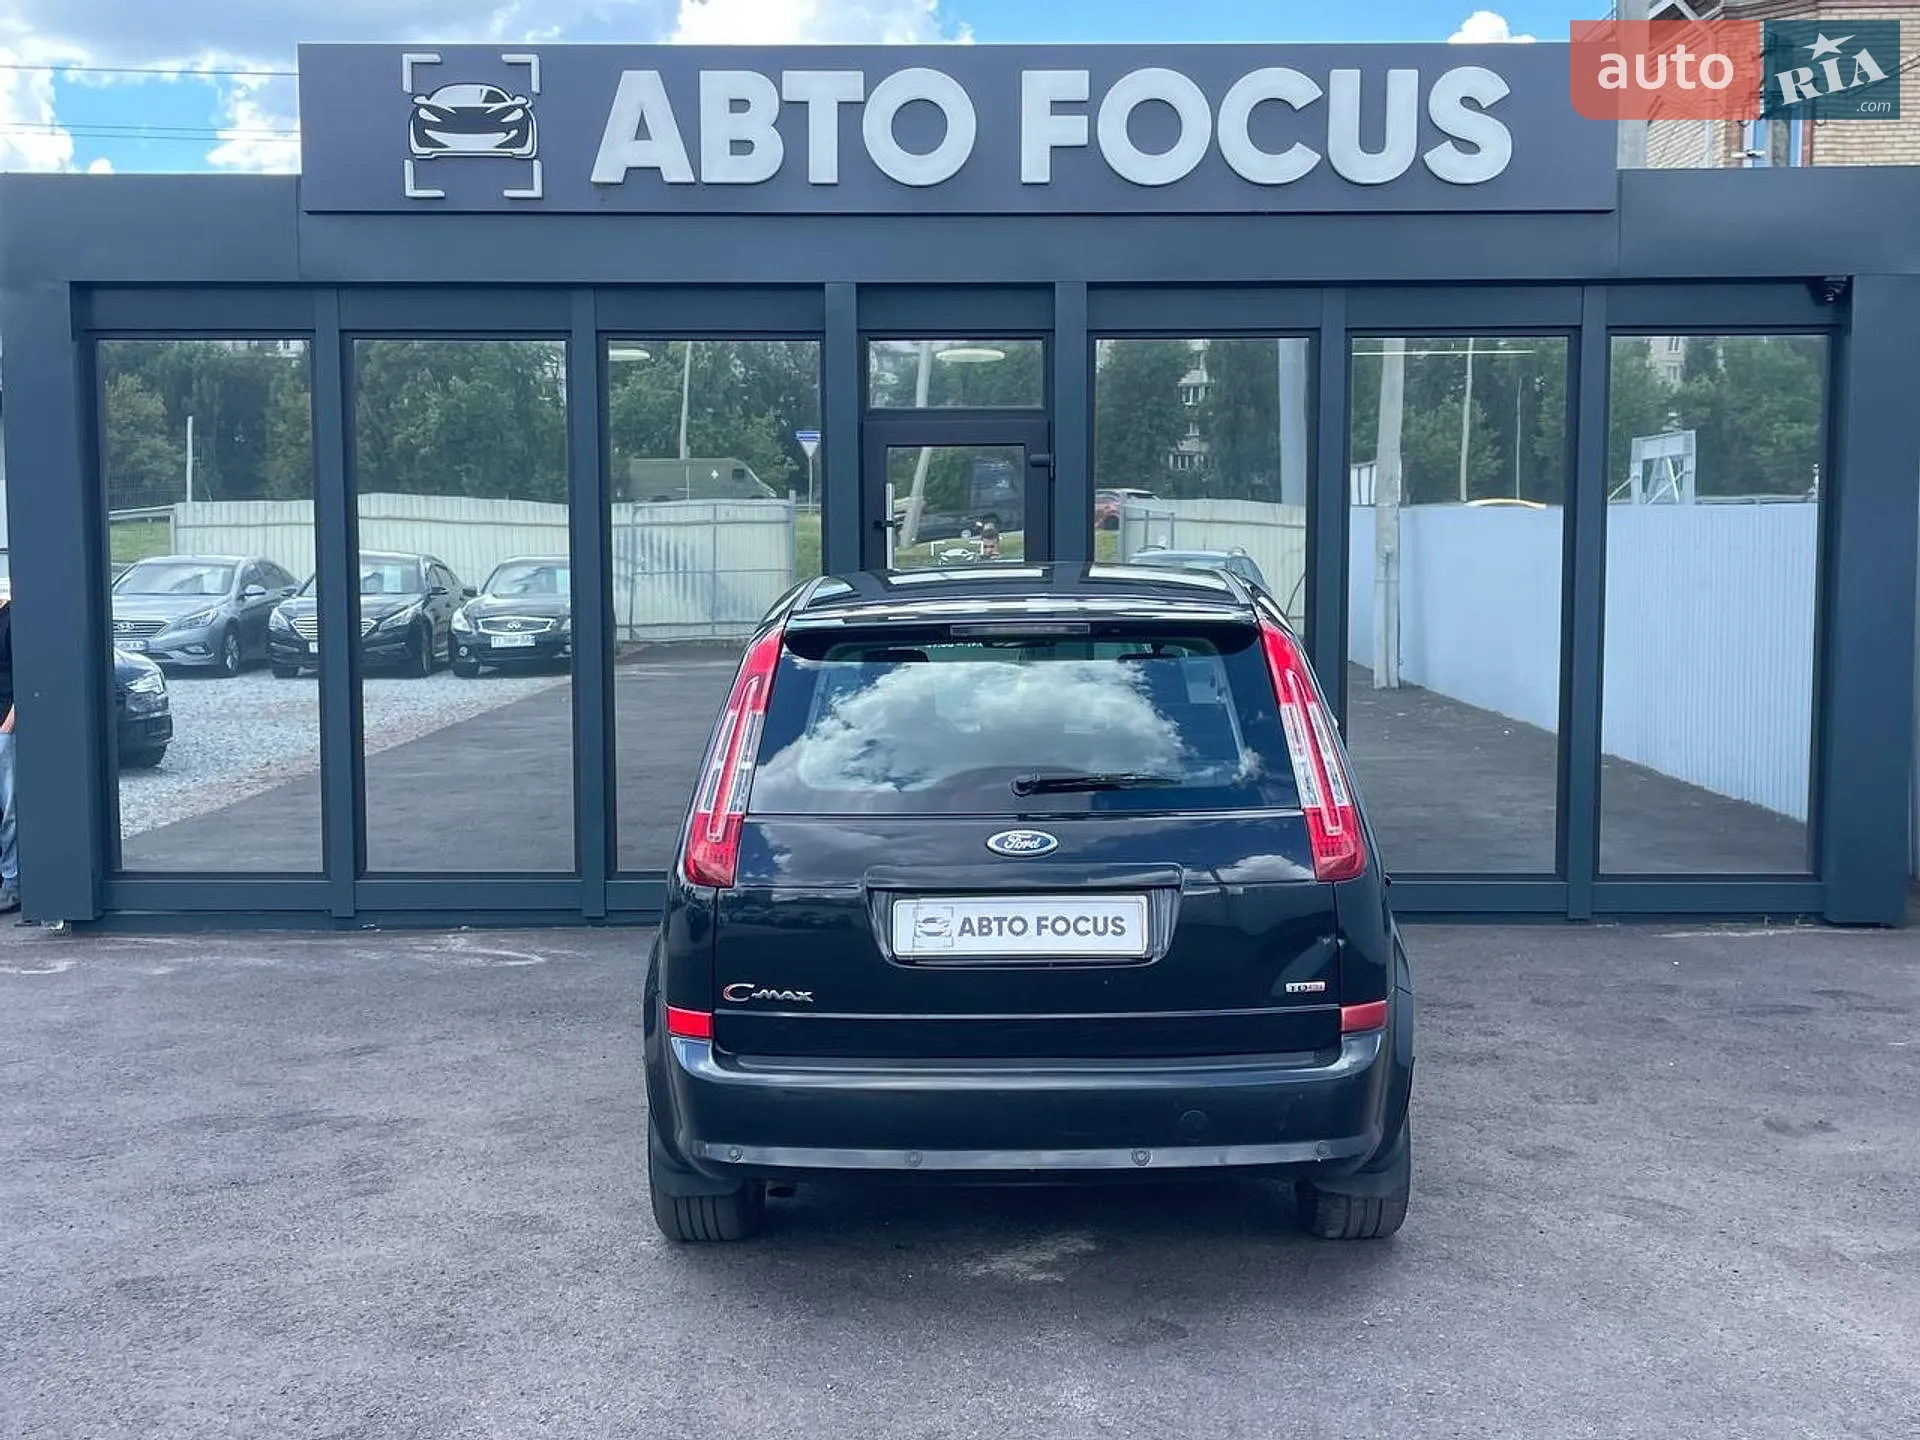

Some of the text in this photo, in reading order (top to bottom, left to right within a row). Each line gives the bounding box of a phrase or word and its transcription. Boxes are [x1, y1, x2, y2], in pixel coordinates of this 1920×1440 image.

[590, 66, 1513, 187] АВТО FOCUS
[1004, 833, 1041, 849] Ford
[957, 915, 1127, 937] АВТО FOCUS
